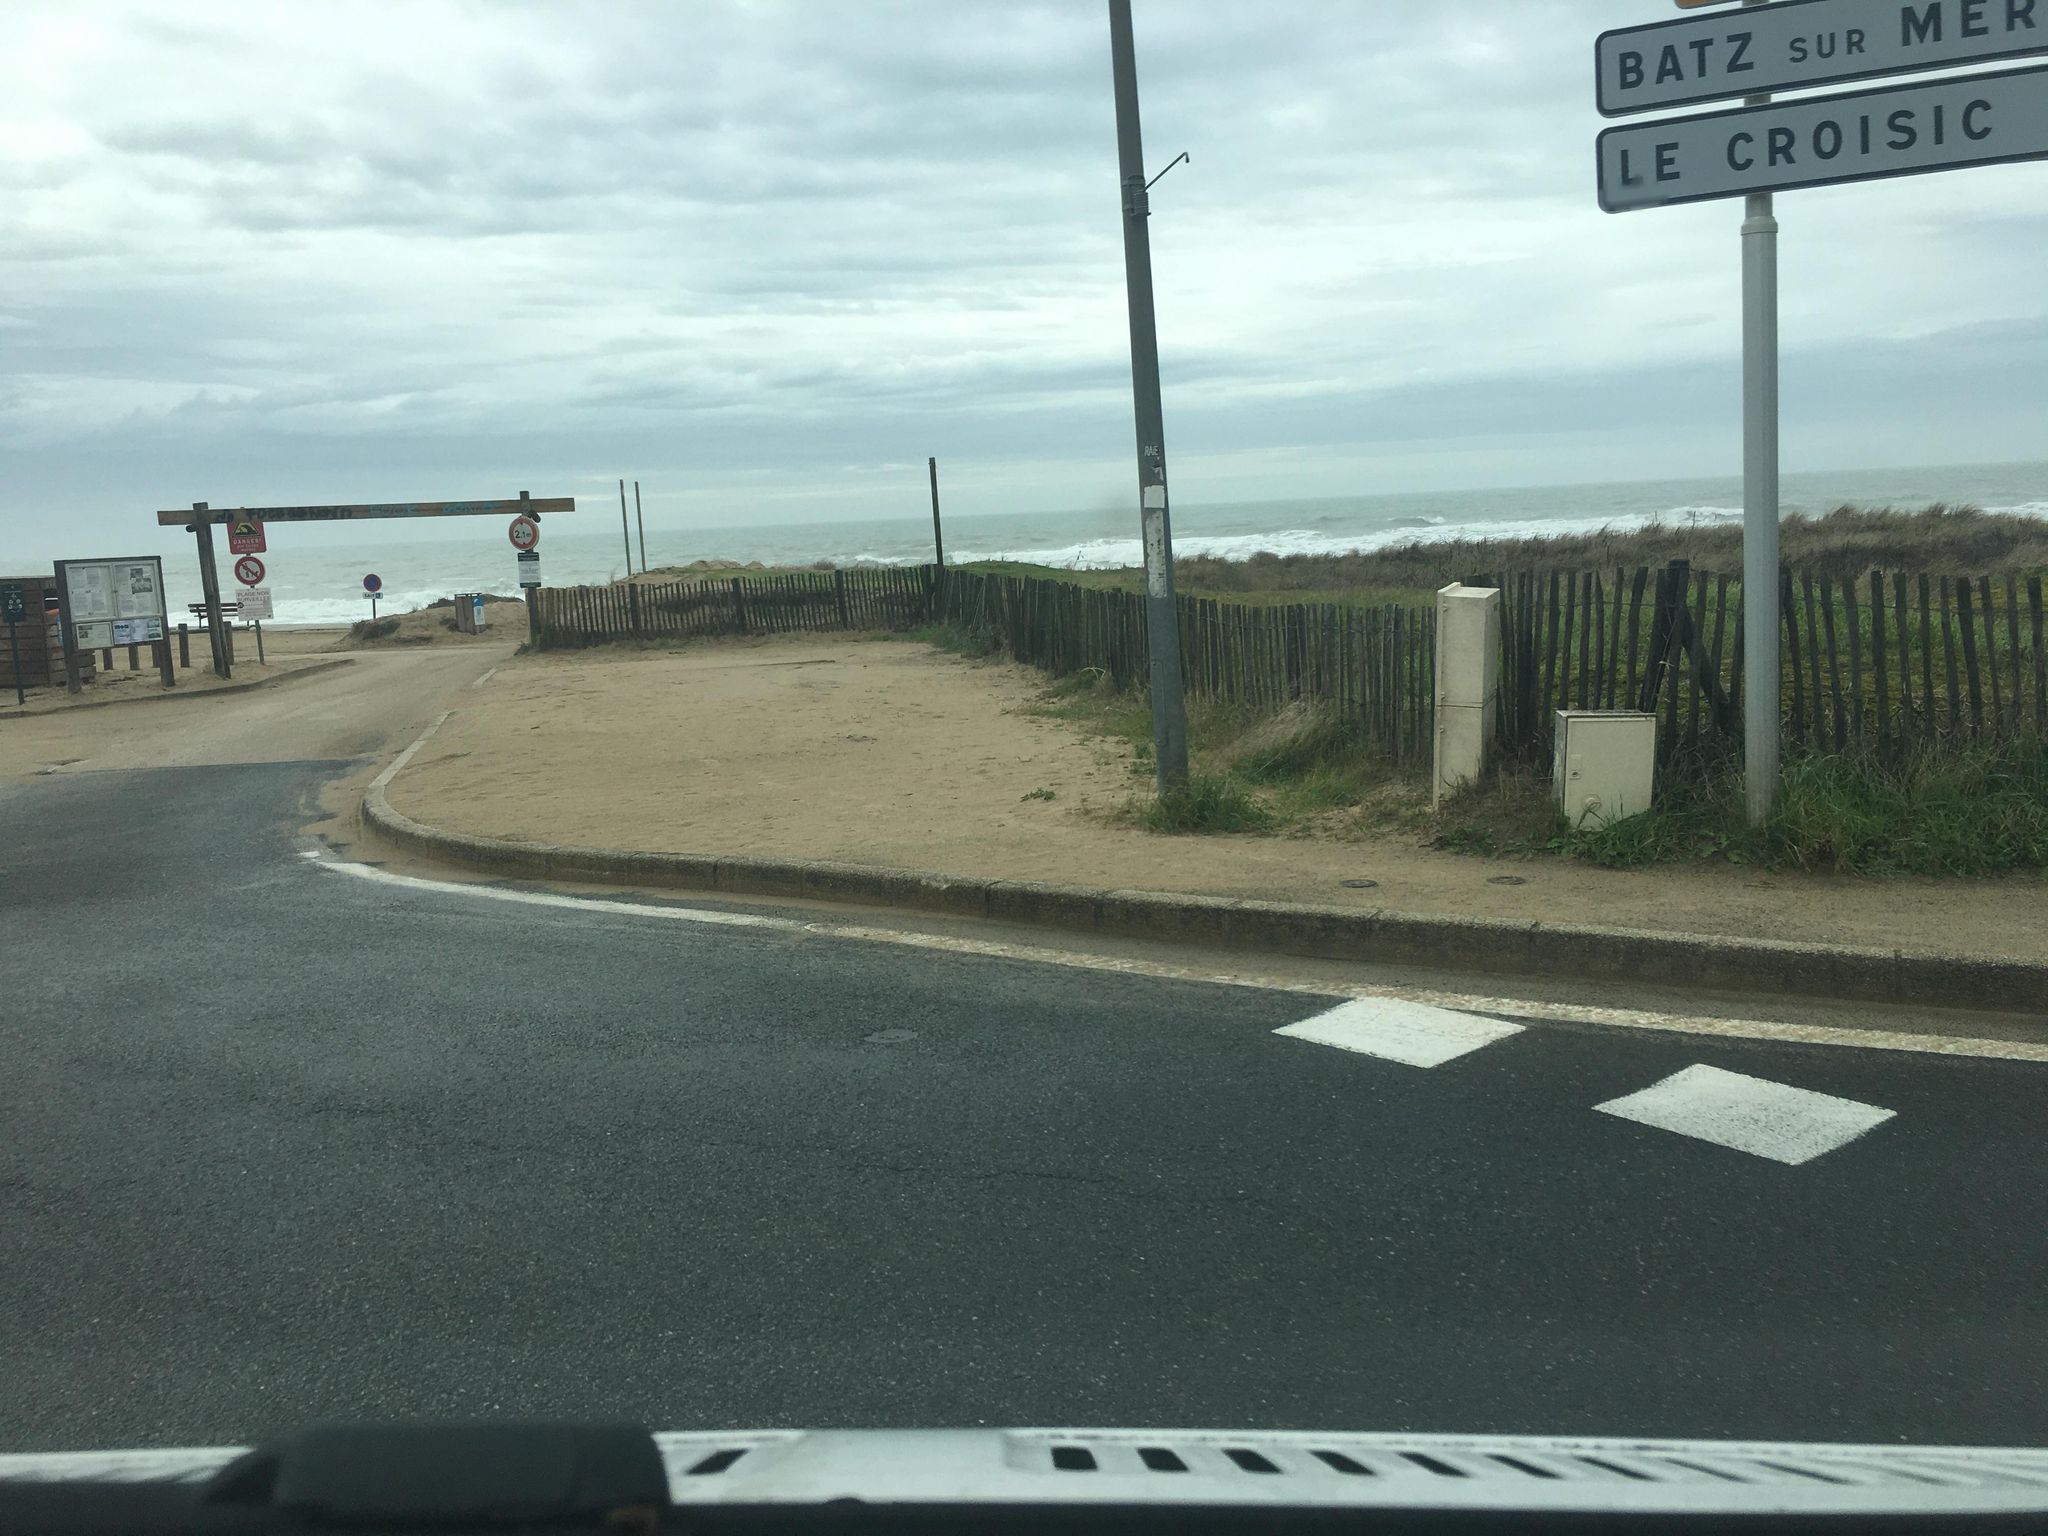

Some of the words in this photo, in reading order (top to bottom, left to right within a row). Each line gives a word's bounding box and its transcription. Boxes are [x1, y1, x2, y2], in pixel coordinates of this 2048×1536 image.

[1619, 32, 1754, 90] BATZ
[1789, 29, 1865, 63] SUR
[1901, 0, 2036, 46] MER
[1620, 142, 1680, 186] LE
[1727, 100, 1992, 171] CROISIC
